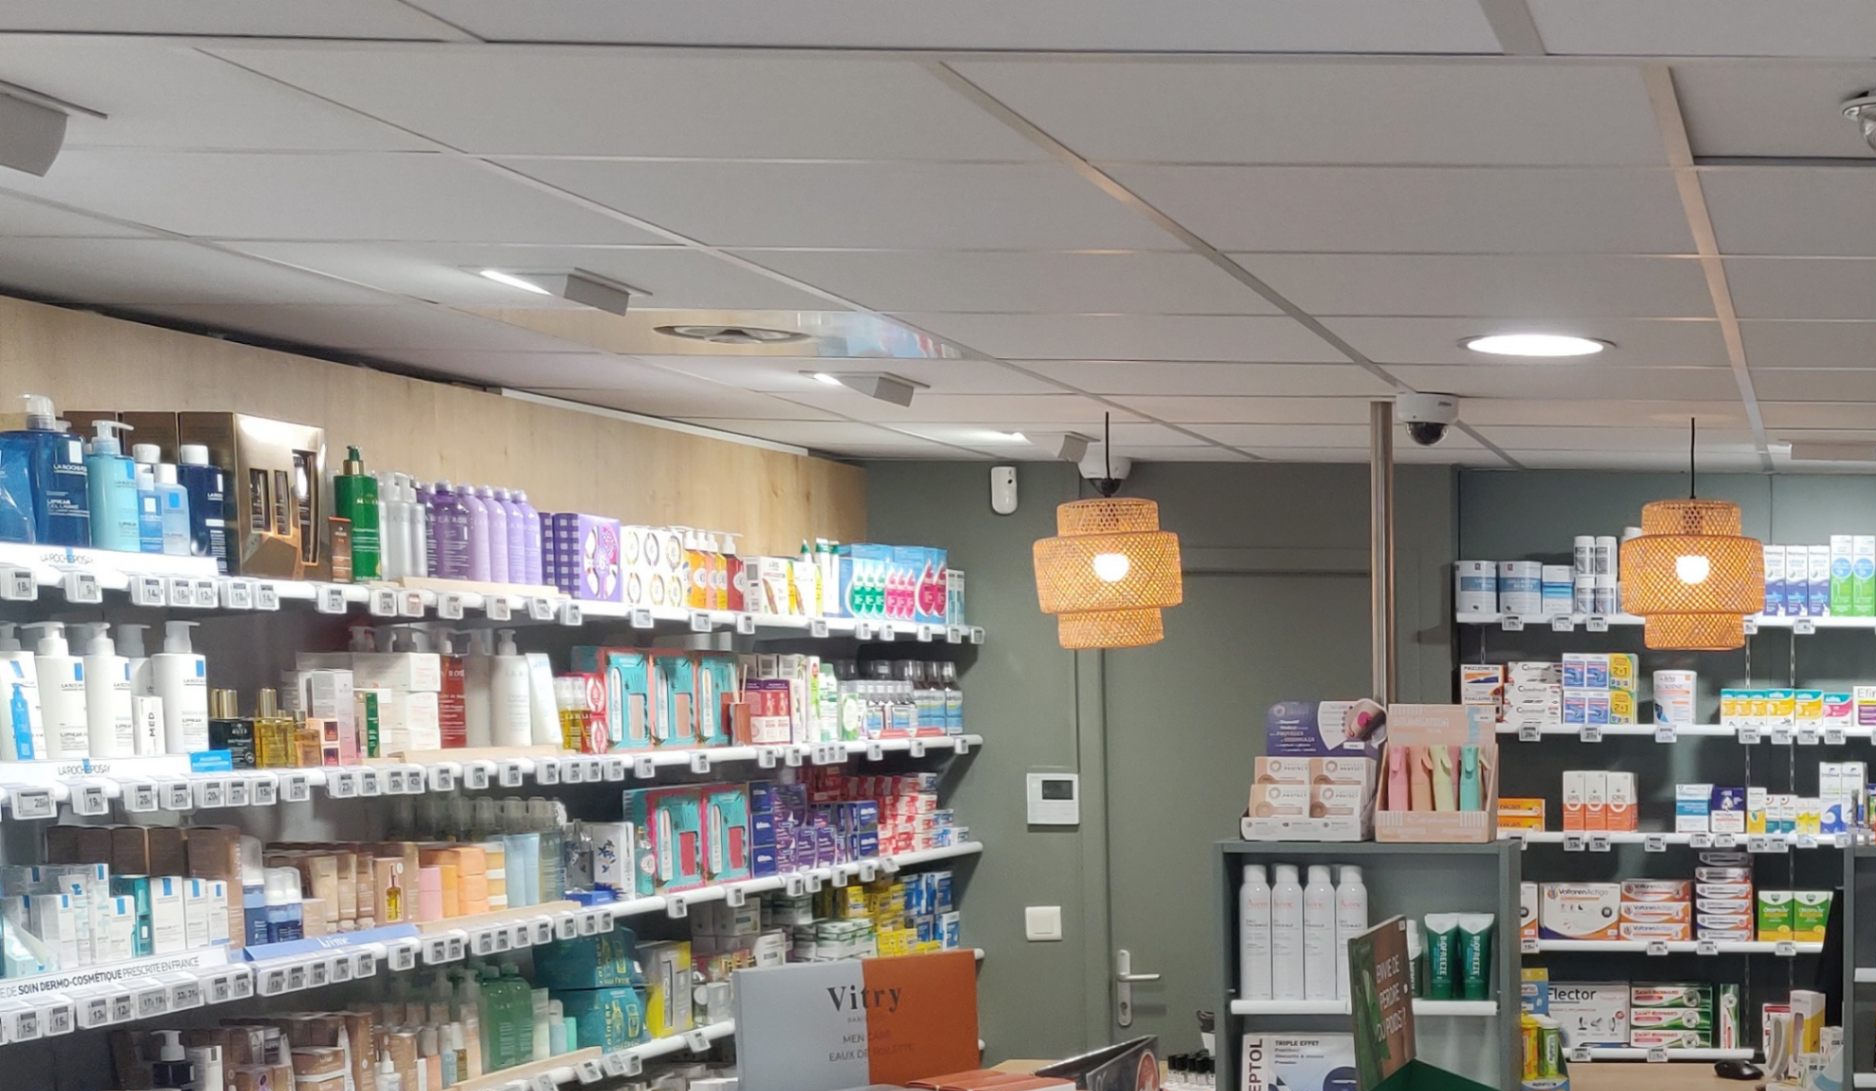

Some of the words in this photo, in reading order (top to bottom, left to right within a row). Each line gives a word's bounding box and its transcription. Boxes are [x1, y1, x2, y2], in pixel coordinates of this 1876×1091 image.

[18, 980, 39, 995] SOIN
[40, 968, 122, 991] DERMO-COSMÉTIQUE
[123, 963, 160, 979] PRESCRITE
[161, 961, 172, 972] EN
[172, 957, 199, 971] FRANCE
[826, 984, 902, 1013] Vitry
[1548, 986, 1597, 1002] Flector
[843, 1033, 865, 1043] MEN
[829, 1051, 855, 1062] EAUX
